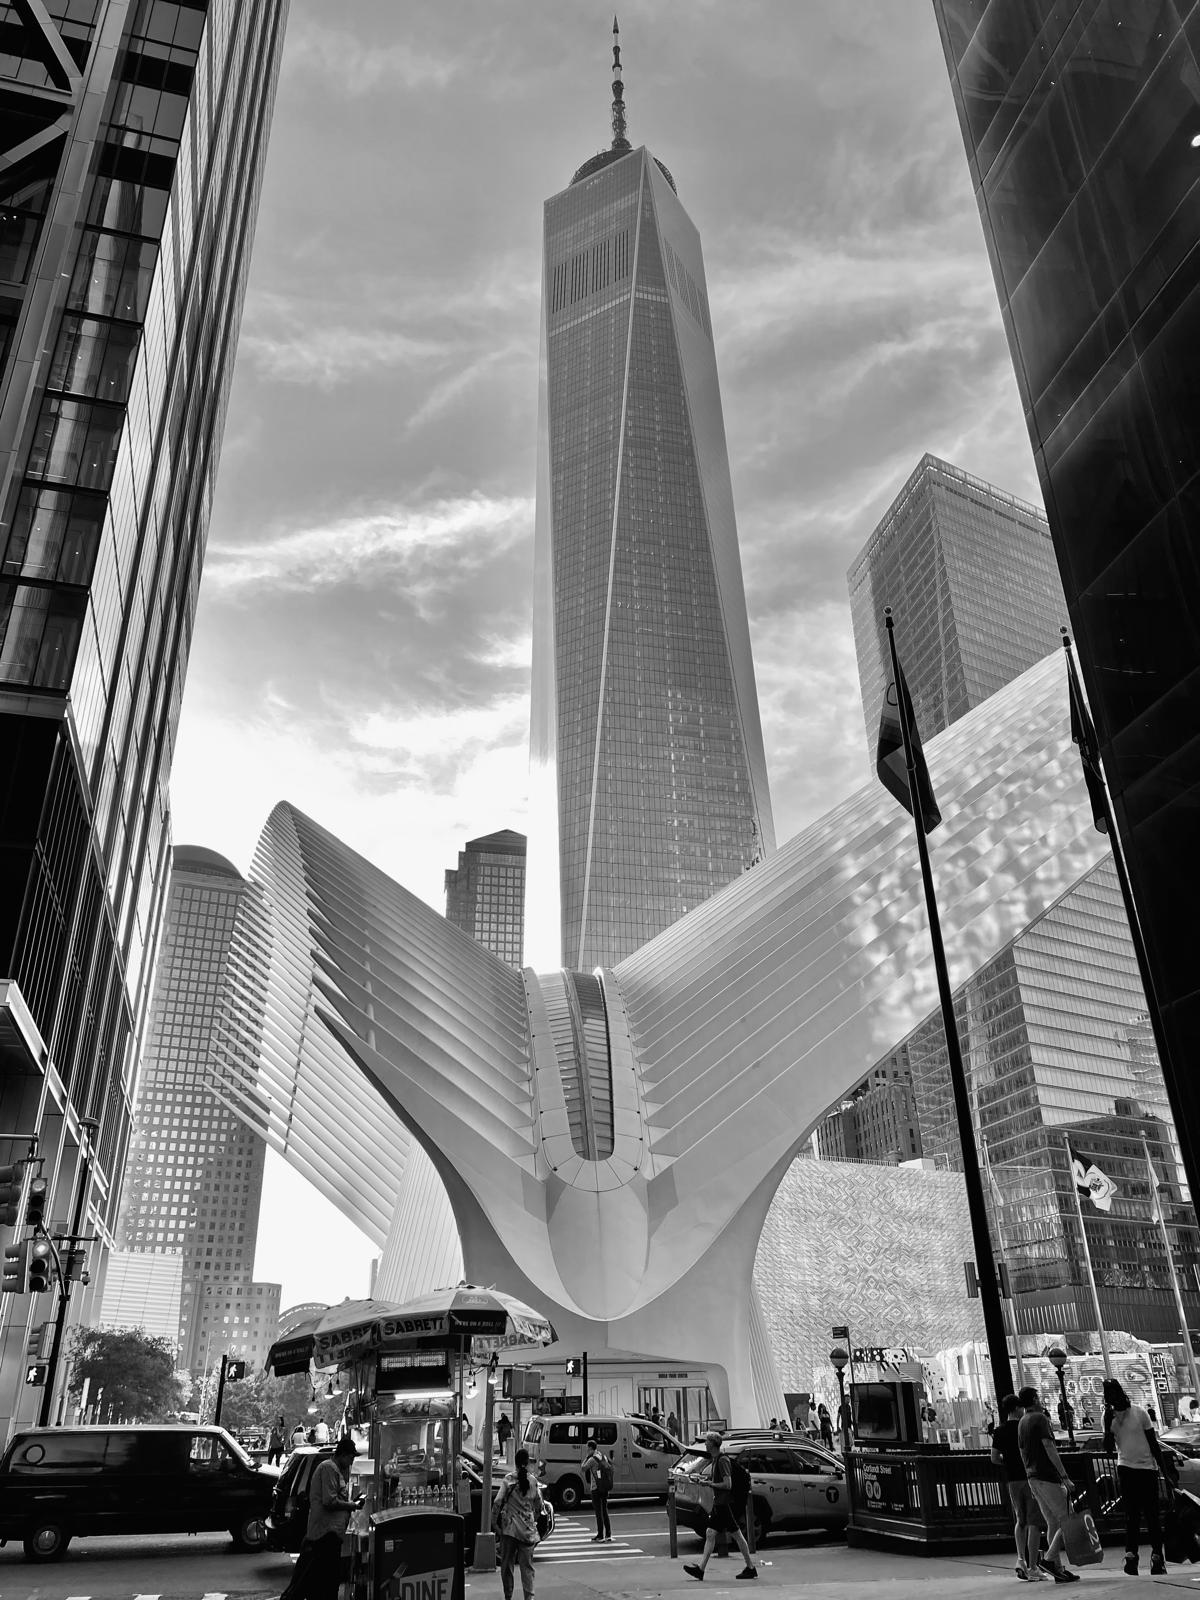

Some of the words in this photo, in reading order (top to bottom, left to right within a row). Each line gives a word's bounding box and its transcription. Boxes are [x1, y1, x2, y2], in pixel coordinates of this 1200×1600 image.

[384, 1317, 445, 1336] SABRETT
[1084, 1513, 1102, 1553] C21
[402, 1579, 449, 1600] DINE
